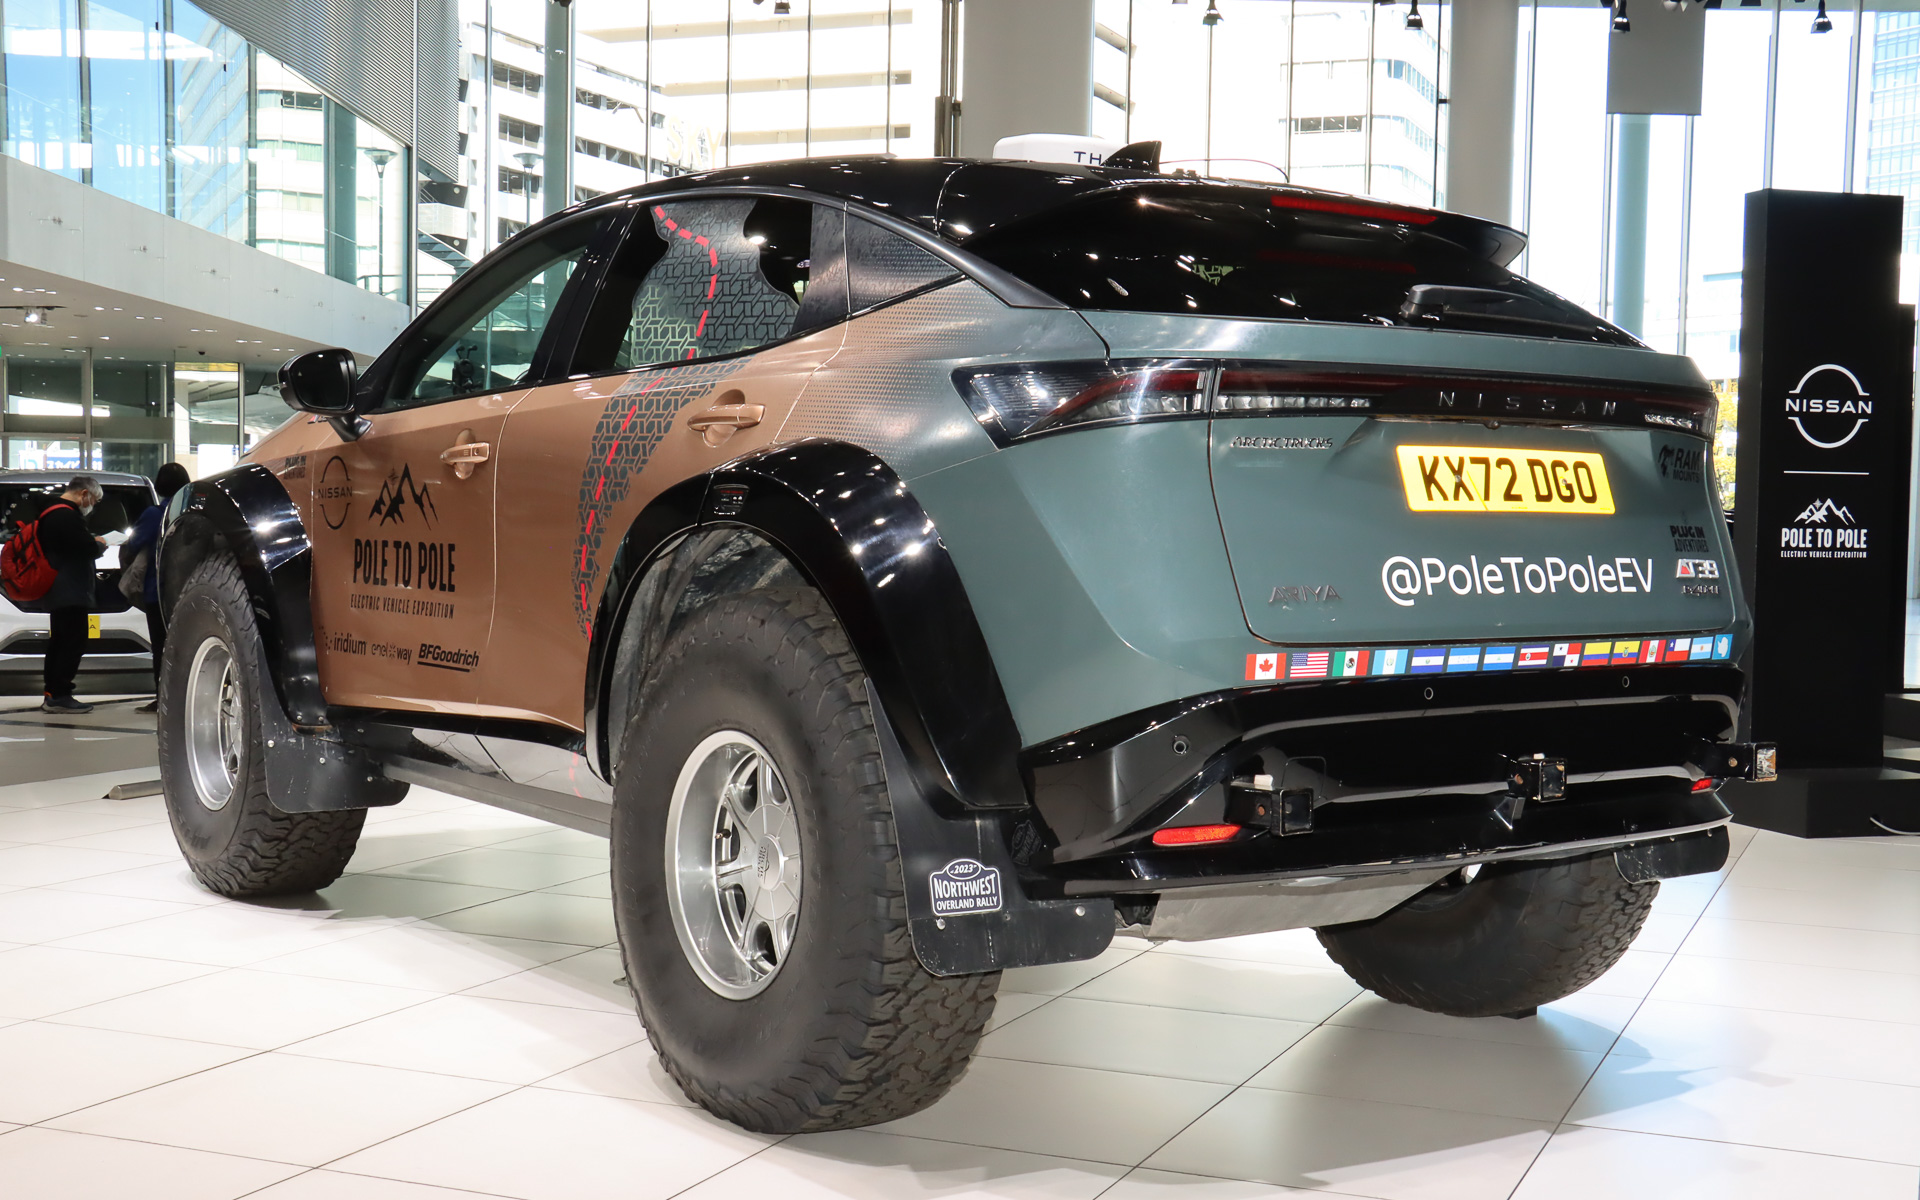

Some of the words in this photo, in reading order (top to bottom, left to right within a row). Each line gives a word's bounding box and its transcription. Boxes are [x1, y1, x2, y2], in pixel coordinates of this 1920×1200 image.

[1439, 391, 1616, 416] NISSAN
[1785, 398, 1872, 414] NISSAN
[1674, 448, 1700, 470] RAM
[1418, 455, 1523, 501] KX72
[1526, 458, 1597, 503] DGO
[318, 486, 353, 499] NISSAN
[1670, 525, 1695, 538] PLUG
[1781, 528, 1813, 548] POLE
[1816, 528, 1832, 548] TO
[1836, 529, 1868, 548] POLE
[1780, 550, 1807, 558] ELECTRIC
[1834, 551, 1867, 559] EXPEDITION
[353, 538, 388, 586] POLE
[393, 540, 412, 588] TO
[417, 541, 456, 593] POLE
[1381, 554, 1654, 607] @PoleToPoleEV
[1268, 584, 1343, 603] ARIYA
[350, 594, 380, 610] ELECTRIC
[383, 597, 410, 614] VEHICLE
[412, 600, 454, 619] EXPEDITION
[334, 632, 366, 656] iridium
[418, 643, 479, 667] BFGoodrich
[954, 864, 973, 874] 2023
[933, 873, 996, 899] NORTHWEST
[936, 898, 974, 910] OVERLAND
[976, 896, 998, 907] RALLY
